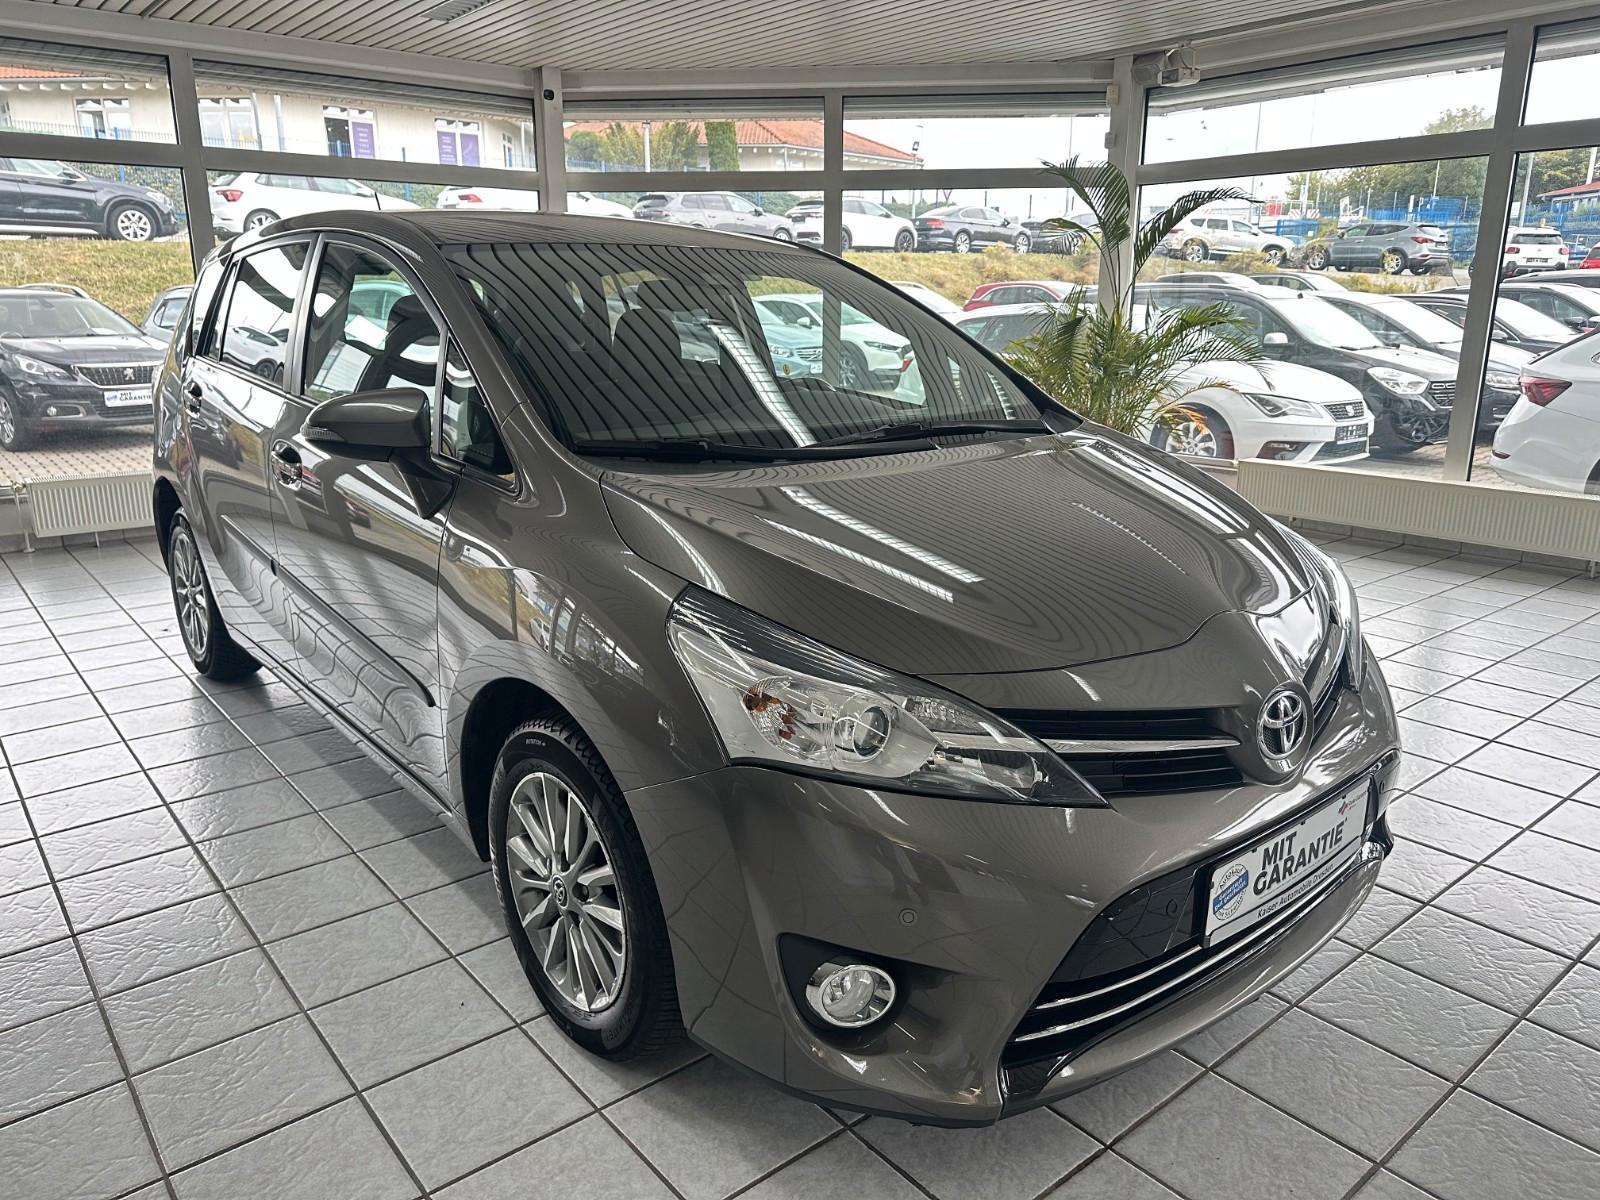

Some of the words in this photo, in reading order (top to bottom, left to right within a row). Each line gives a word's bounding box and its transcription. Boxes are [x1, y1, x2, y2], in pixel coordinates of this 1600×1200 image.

[1261, 831, 1298, 870] MIT
[1258, 902, 1278, 919] Kaiser
[1278, 880, 1312, 905] Automobile
